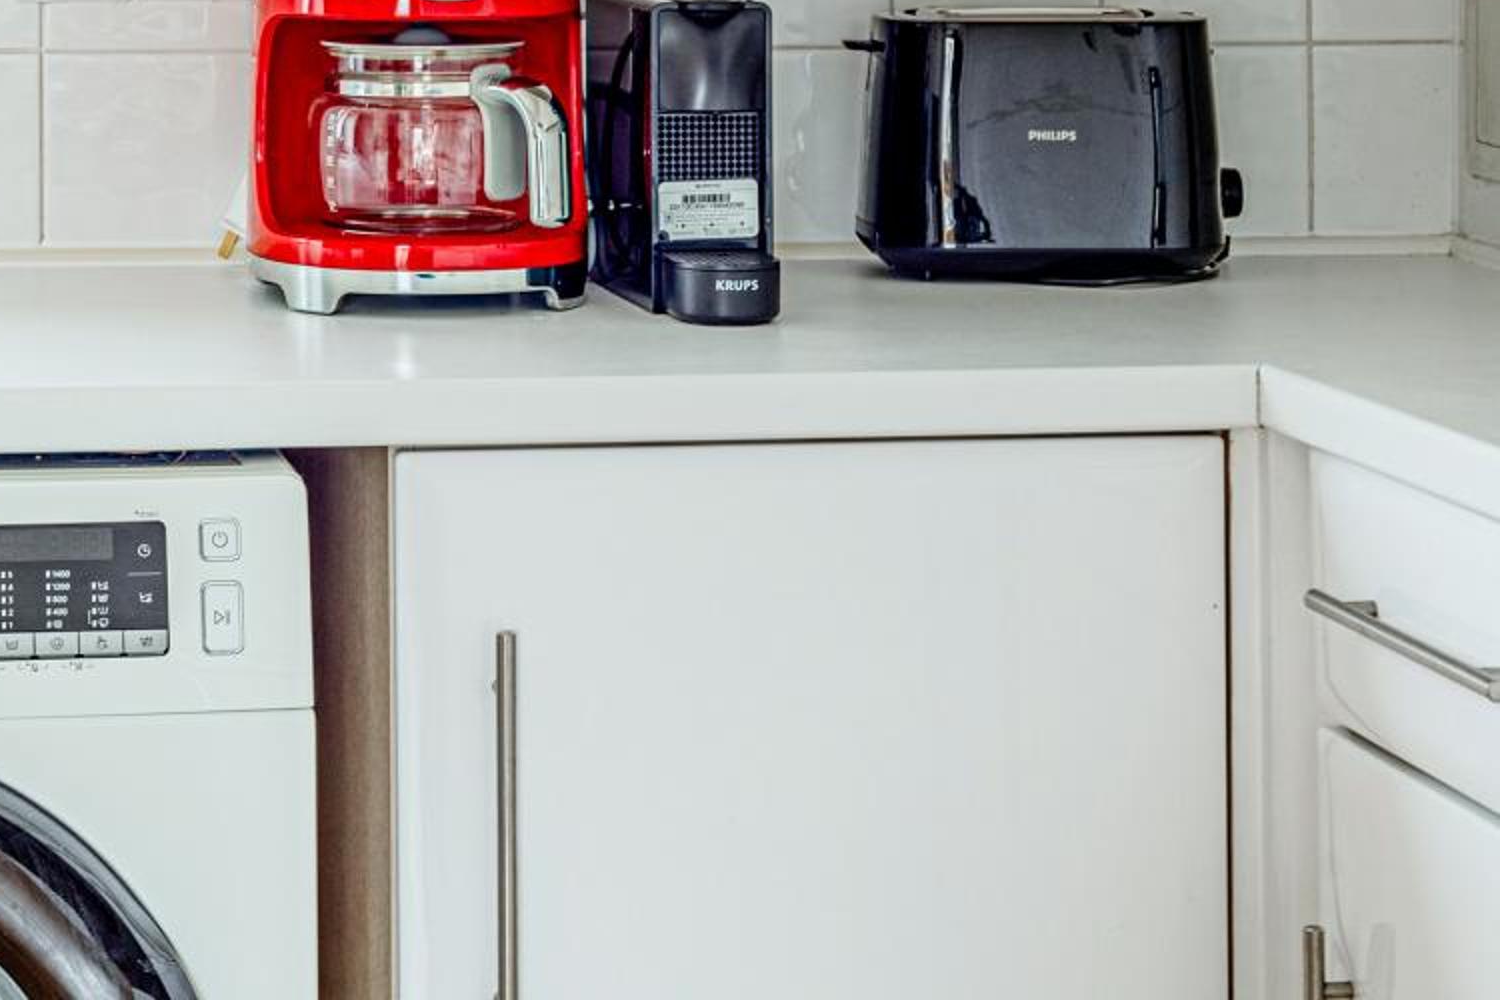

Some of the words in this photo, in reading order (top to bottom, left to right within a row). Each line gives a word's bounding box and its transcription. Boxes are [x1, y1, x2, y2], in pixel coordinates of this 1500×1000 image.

[1028, 129, 1077, 141] PHILIPS
[715, 279, 759, 291] KRUPS
[52, 569, 71, 579] 1400
[52, 582, 71, 591] 1200
